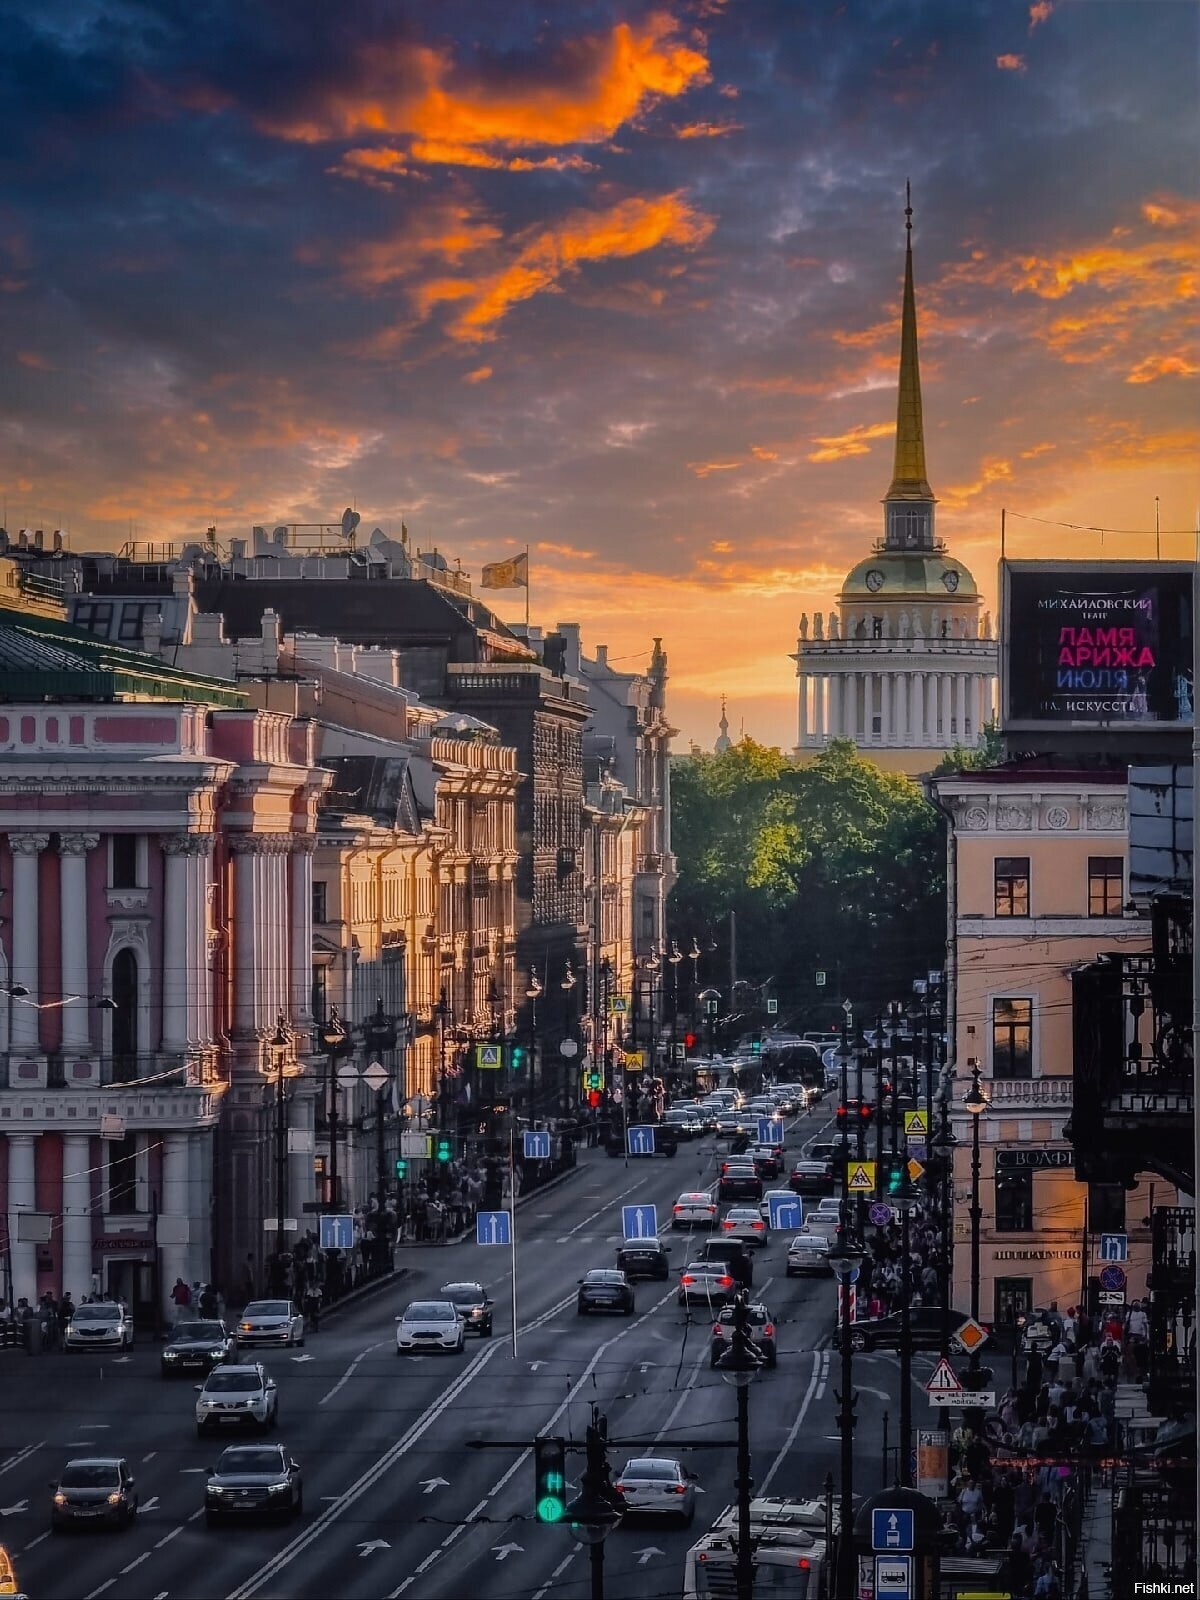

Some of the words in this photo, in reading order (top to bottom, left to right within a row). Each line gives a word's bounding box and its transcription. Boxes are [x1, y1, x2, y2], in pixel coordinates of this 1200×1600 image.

[1037, 597, 1153, 609] МИХАЙЛОВСКИЙ
[1059, 627, 1136, 646] ЛАМЯ
[1058, 647, 1156, 667] АРИЖА
[1057, 669, 1129, 688] ИЮЛЯ
